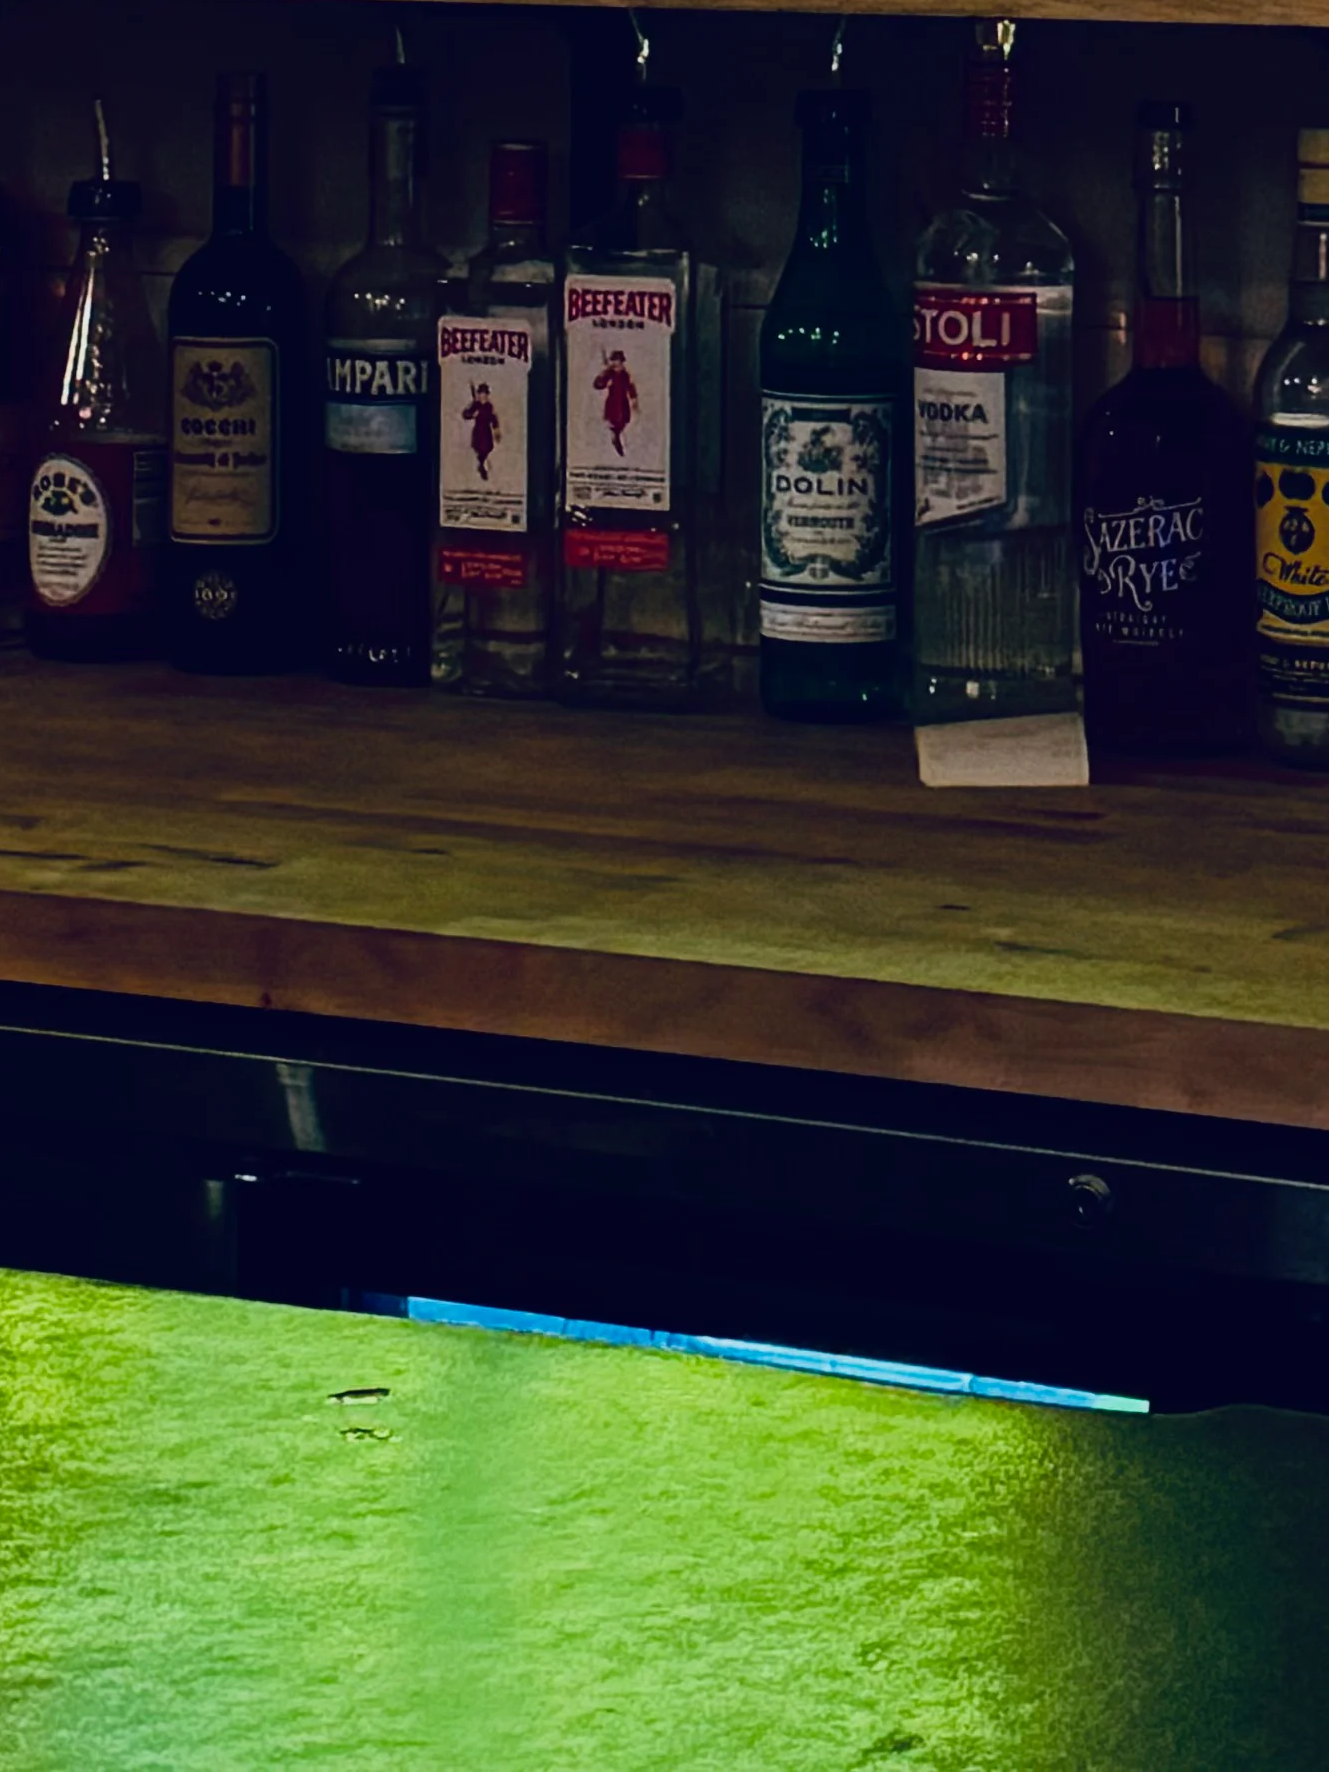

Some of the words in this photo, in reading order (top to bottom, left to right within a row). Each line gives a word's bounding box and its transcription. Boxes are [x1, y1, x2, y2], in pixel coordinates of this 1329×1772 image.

[568, 288, 672, 327] BEEFEATER
[441, 327, 529, 363] BEEFEATER
[326, 356, 429, 396] MPARI
[918, 399, 989, 424] VODKA
[775, 474, 869, 497] DOLIN
[1082, 506, 1204, 576] SAZERAC
[1108, 554, 1180, 612] RYE
